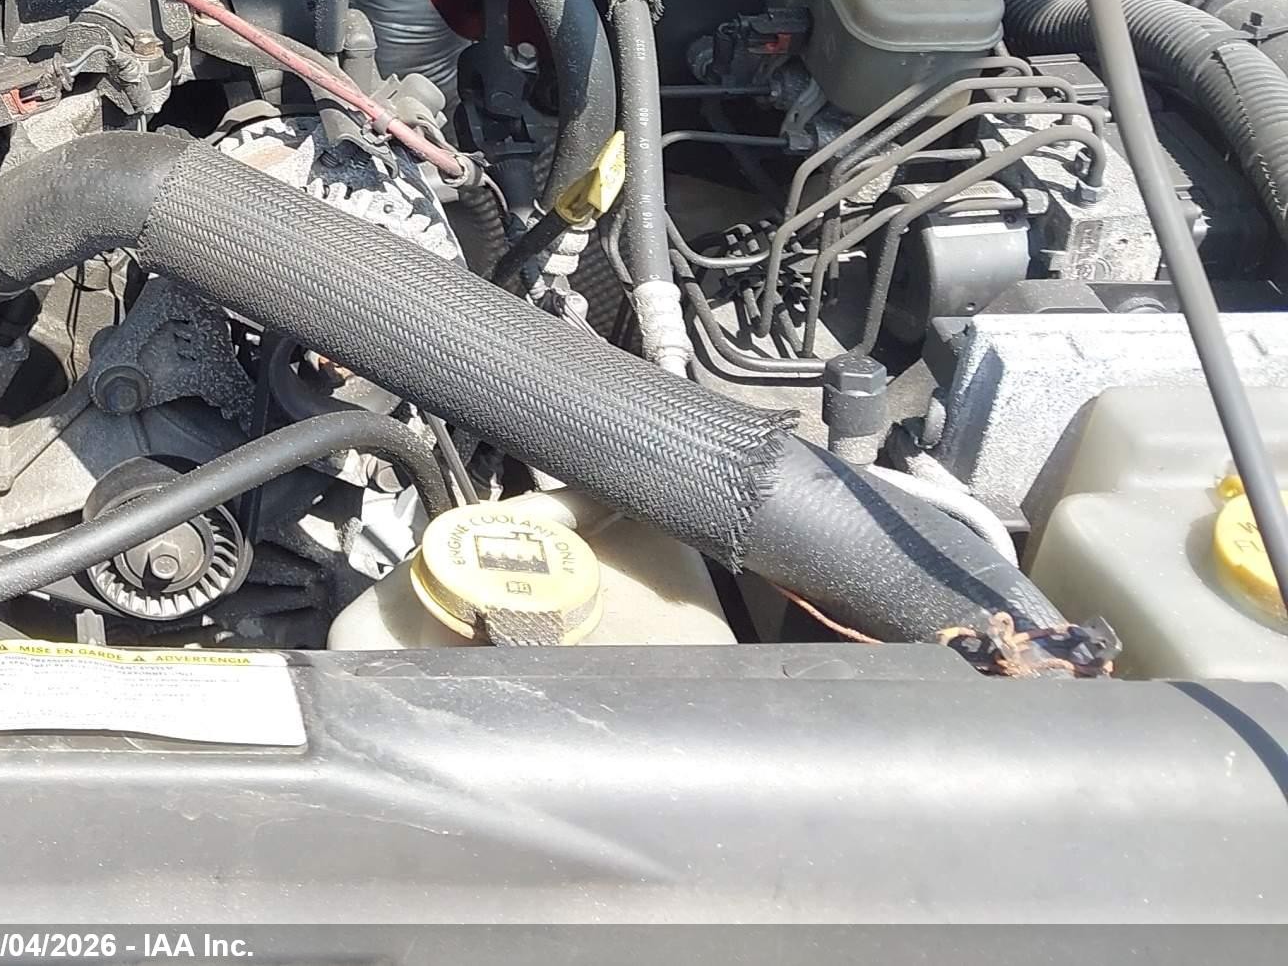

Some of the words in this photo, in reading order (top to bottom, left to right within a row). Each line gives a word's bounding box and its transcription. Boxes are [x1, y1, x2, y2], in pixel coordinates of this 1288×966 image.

[448, 524, 470, 565] ENGINE
[470, 514, 558, 539] COOLANT
[555, 542, 575, 574] ONLY
[19, 645, 55, 654] MISE
[57, 647, 74, 655] EN
[78, 647, 124, 661] GARDE
[155, 655, 251, 664] ADVERTENCIA
